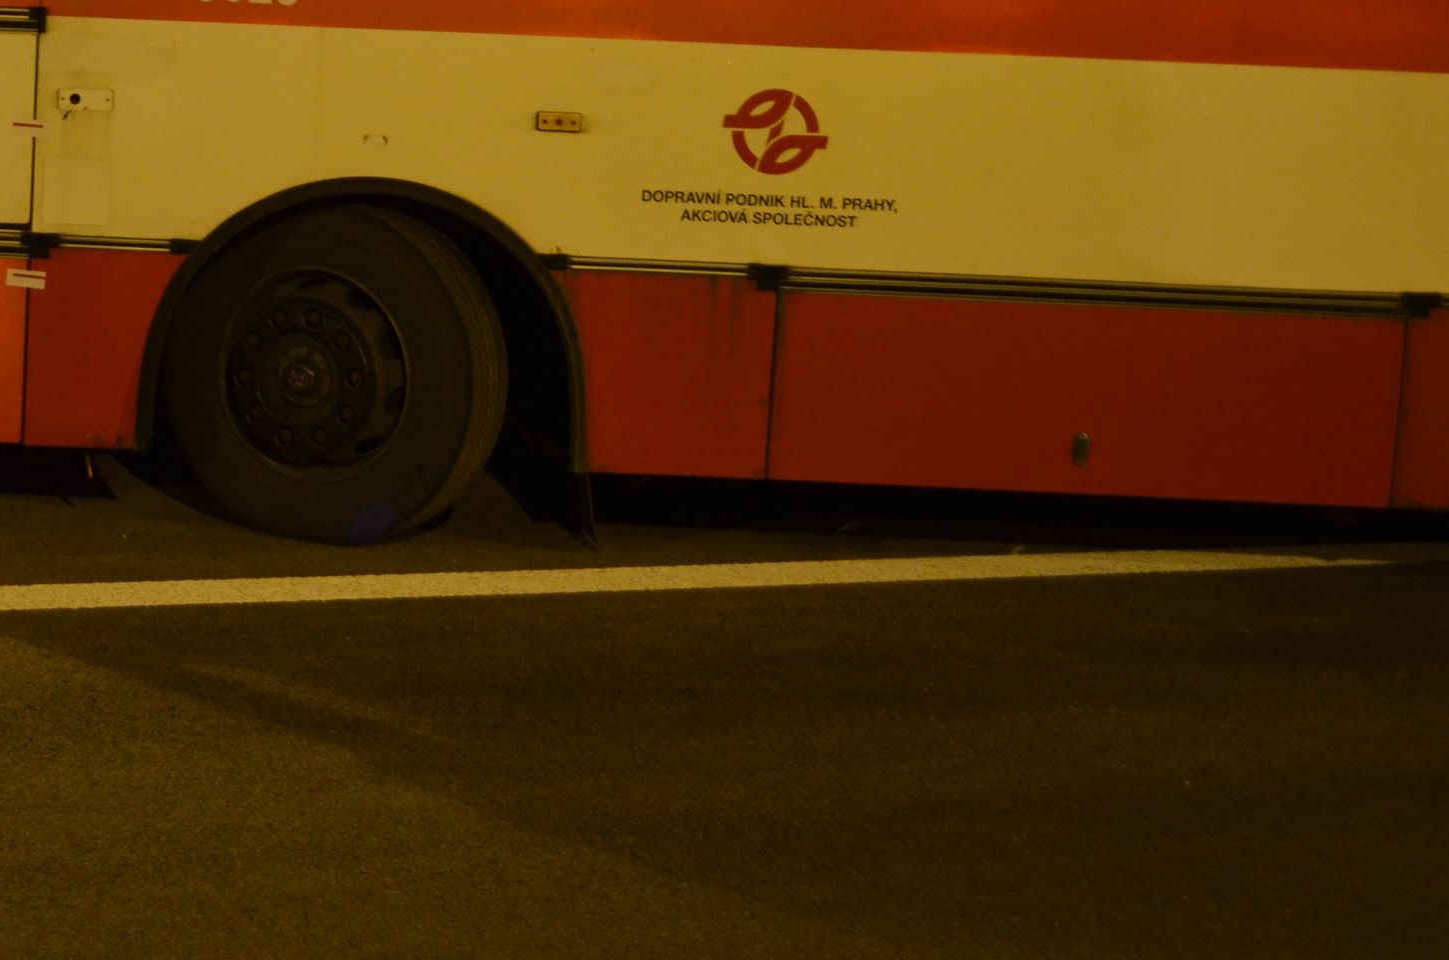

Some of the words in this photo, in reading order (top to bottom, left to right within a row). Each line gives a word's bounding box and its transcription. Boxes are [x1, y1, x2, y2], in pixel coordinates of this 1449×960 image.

[641, 189, 721, 205] DOPRAVNÍ
[725, 193, 784, 208] PODNIK
[790, 196, 815, 209] HL.
[819, 197, 837, 210] M.
[842, 198, 898, 214] PRAHY,
[680, 208, 748, 224] AKCIOVÁ
[752, 210, 857, 228] SPOLEČNOST
